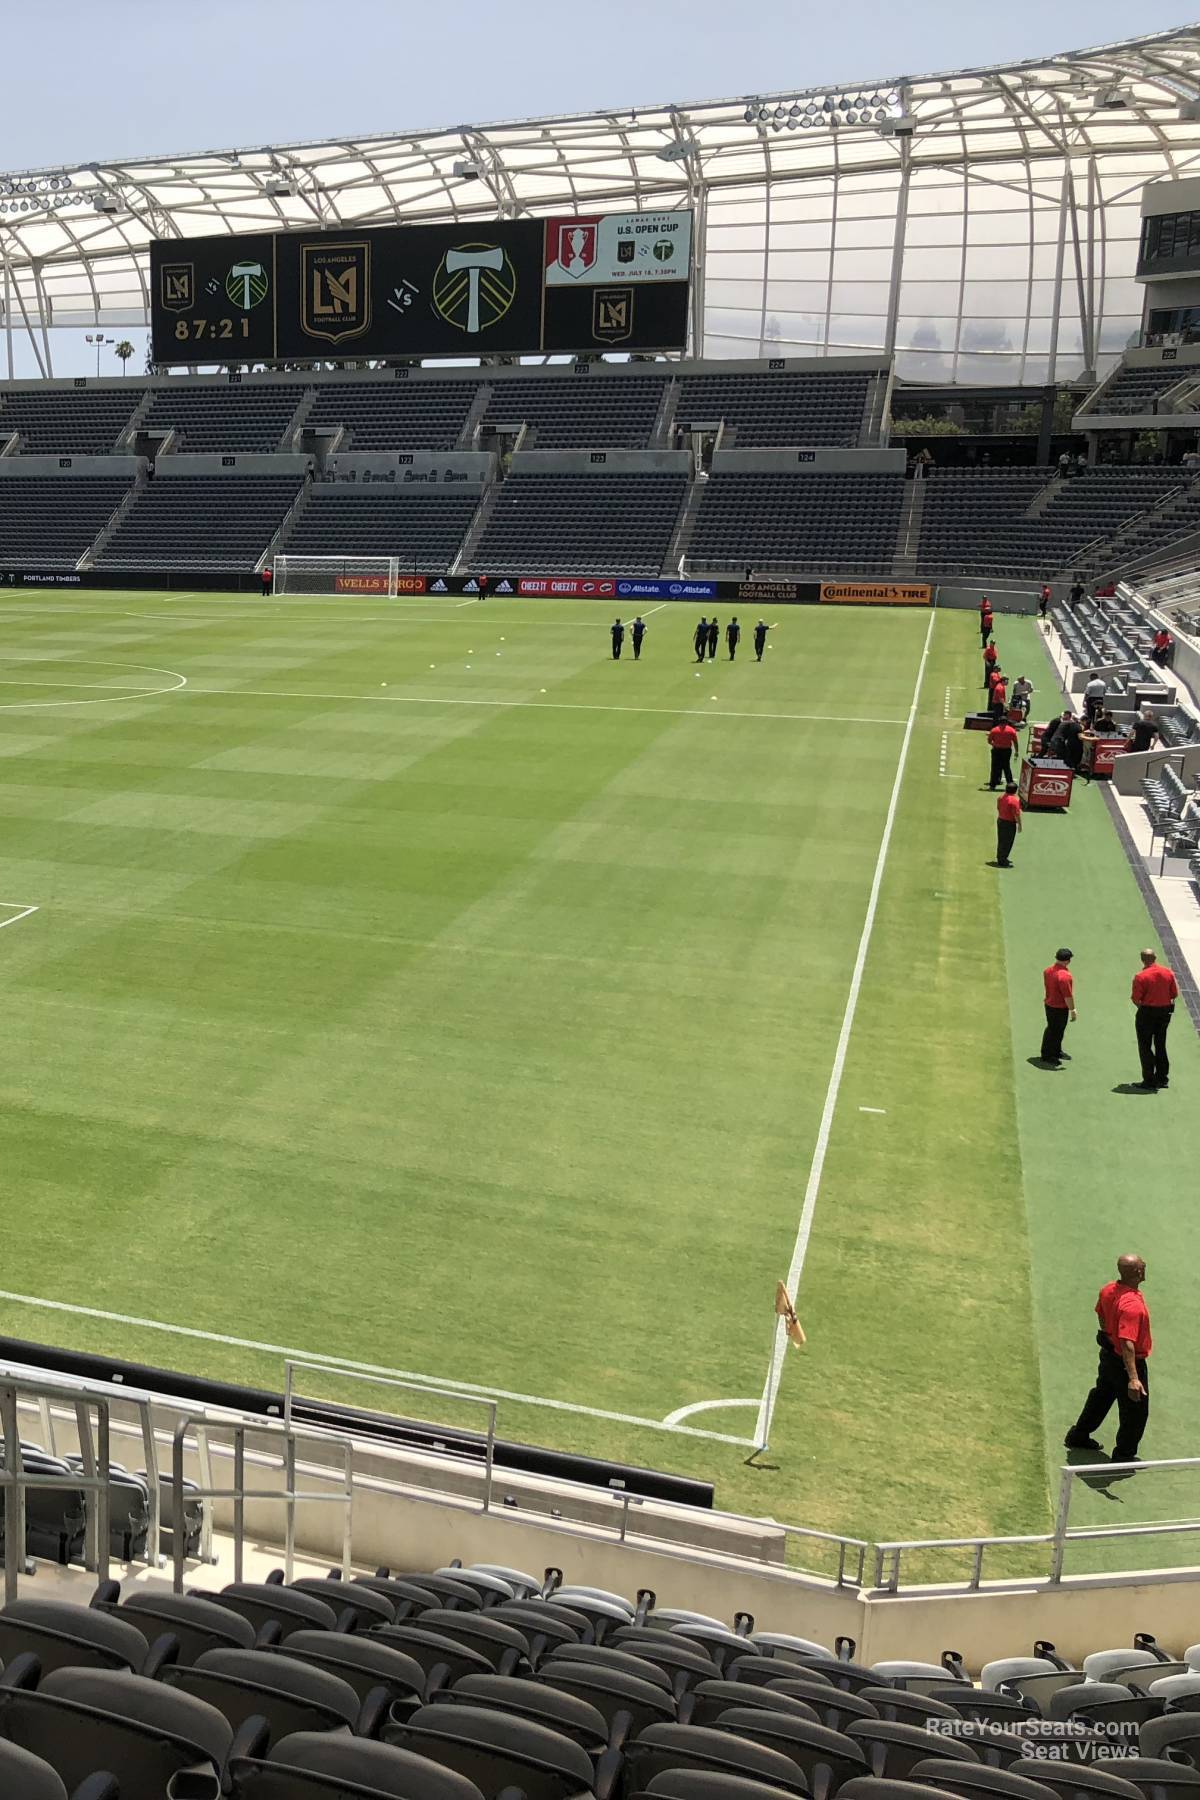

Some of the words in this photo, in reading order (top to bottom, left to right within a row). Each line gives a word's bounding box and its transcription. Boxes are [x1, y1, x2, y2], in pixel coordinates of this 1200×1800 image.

[617, 226, 634, 235] U.S.
[635, 225, 659, 234] OPEN
[661, 224, 679, 232] CUP
[327, 255, 357, 263] ANGELES
[394, 288, 413, 306] VS
[175, 318, 249, 340] 87:21
[339, 579, 380, 588] WELLS
[757, 584, 798, 592] ANGELES
[823, 586, 888, 599] Continental
[901, 590, 927, 598] TIRE
